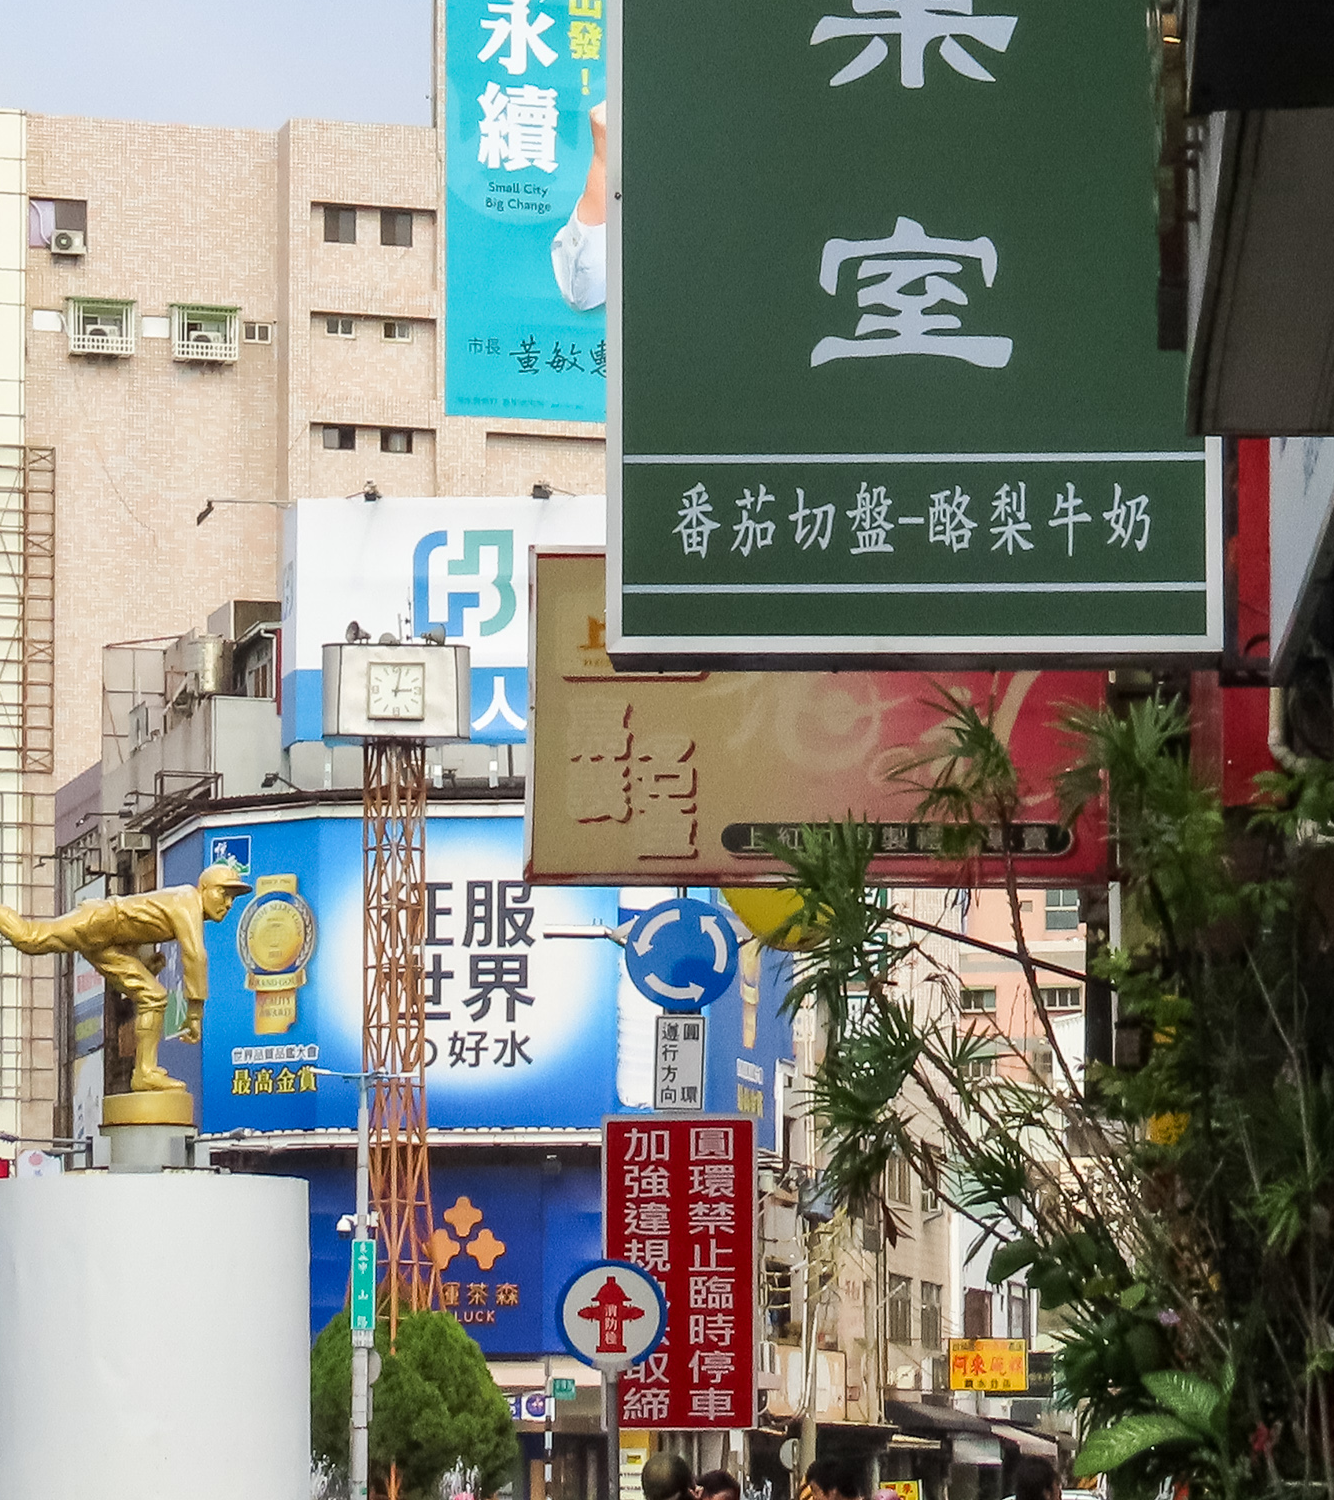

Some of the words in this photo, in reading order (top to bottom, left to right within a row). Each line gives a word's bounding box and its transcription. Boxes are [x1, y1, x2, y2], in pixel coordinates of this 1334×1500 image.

[485, 197, 505, 214] Big
[508, 198, 552, 214] Change
[488, 181, 519, 196] Small
[523, 184, 549, 200] City
[671, 481, 1151, 559] 番茄切盤-酪梨牛奶
[231, 1066, 318, 1095] 最高金賞
[660, 1022, 679, 1104] 遵行方向
[623, 1128, 671, 1421] 加強違規取締
[688, 1127, 736, 1422] 圓環禁止臨時停車
[454, 1310, 495, 1324] LUCK
